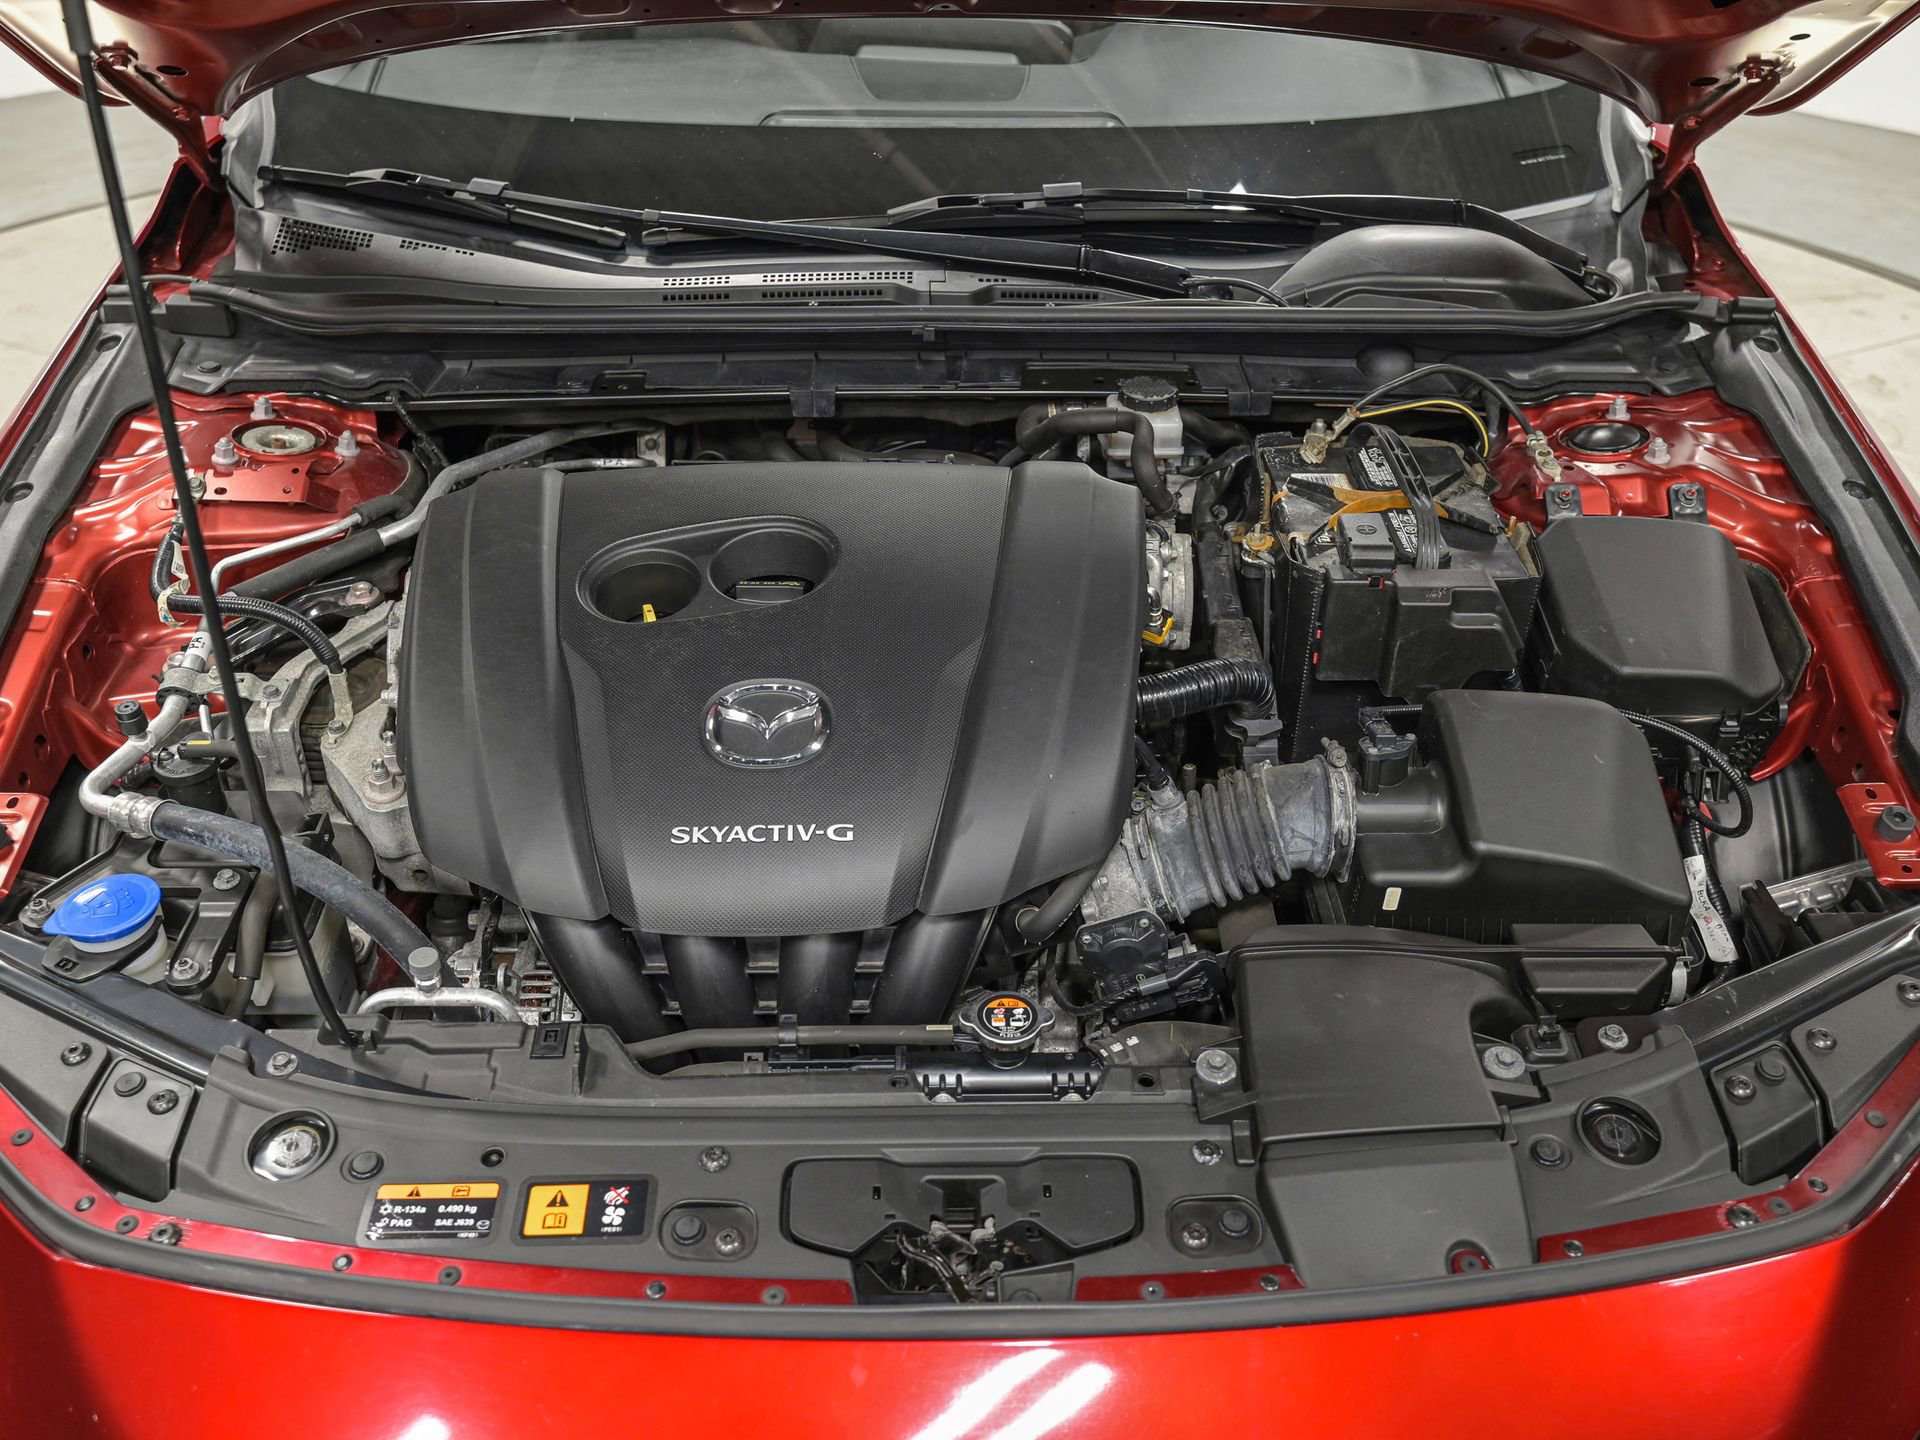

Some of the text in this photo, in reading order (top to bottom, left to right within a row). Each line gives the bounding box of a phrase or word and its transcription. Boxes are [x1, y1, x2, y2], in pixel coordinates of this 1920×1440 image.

[670, 823, 854, 844] SKYACTIV-G
[393, 1204, 478, 1215] R-134a 0.490 kg
[389, 1218, 475, 1227] PAG SAE J639
